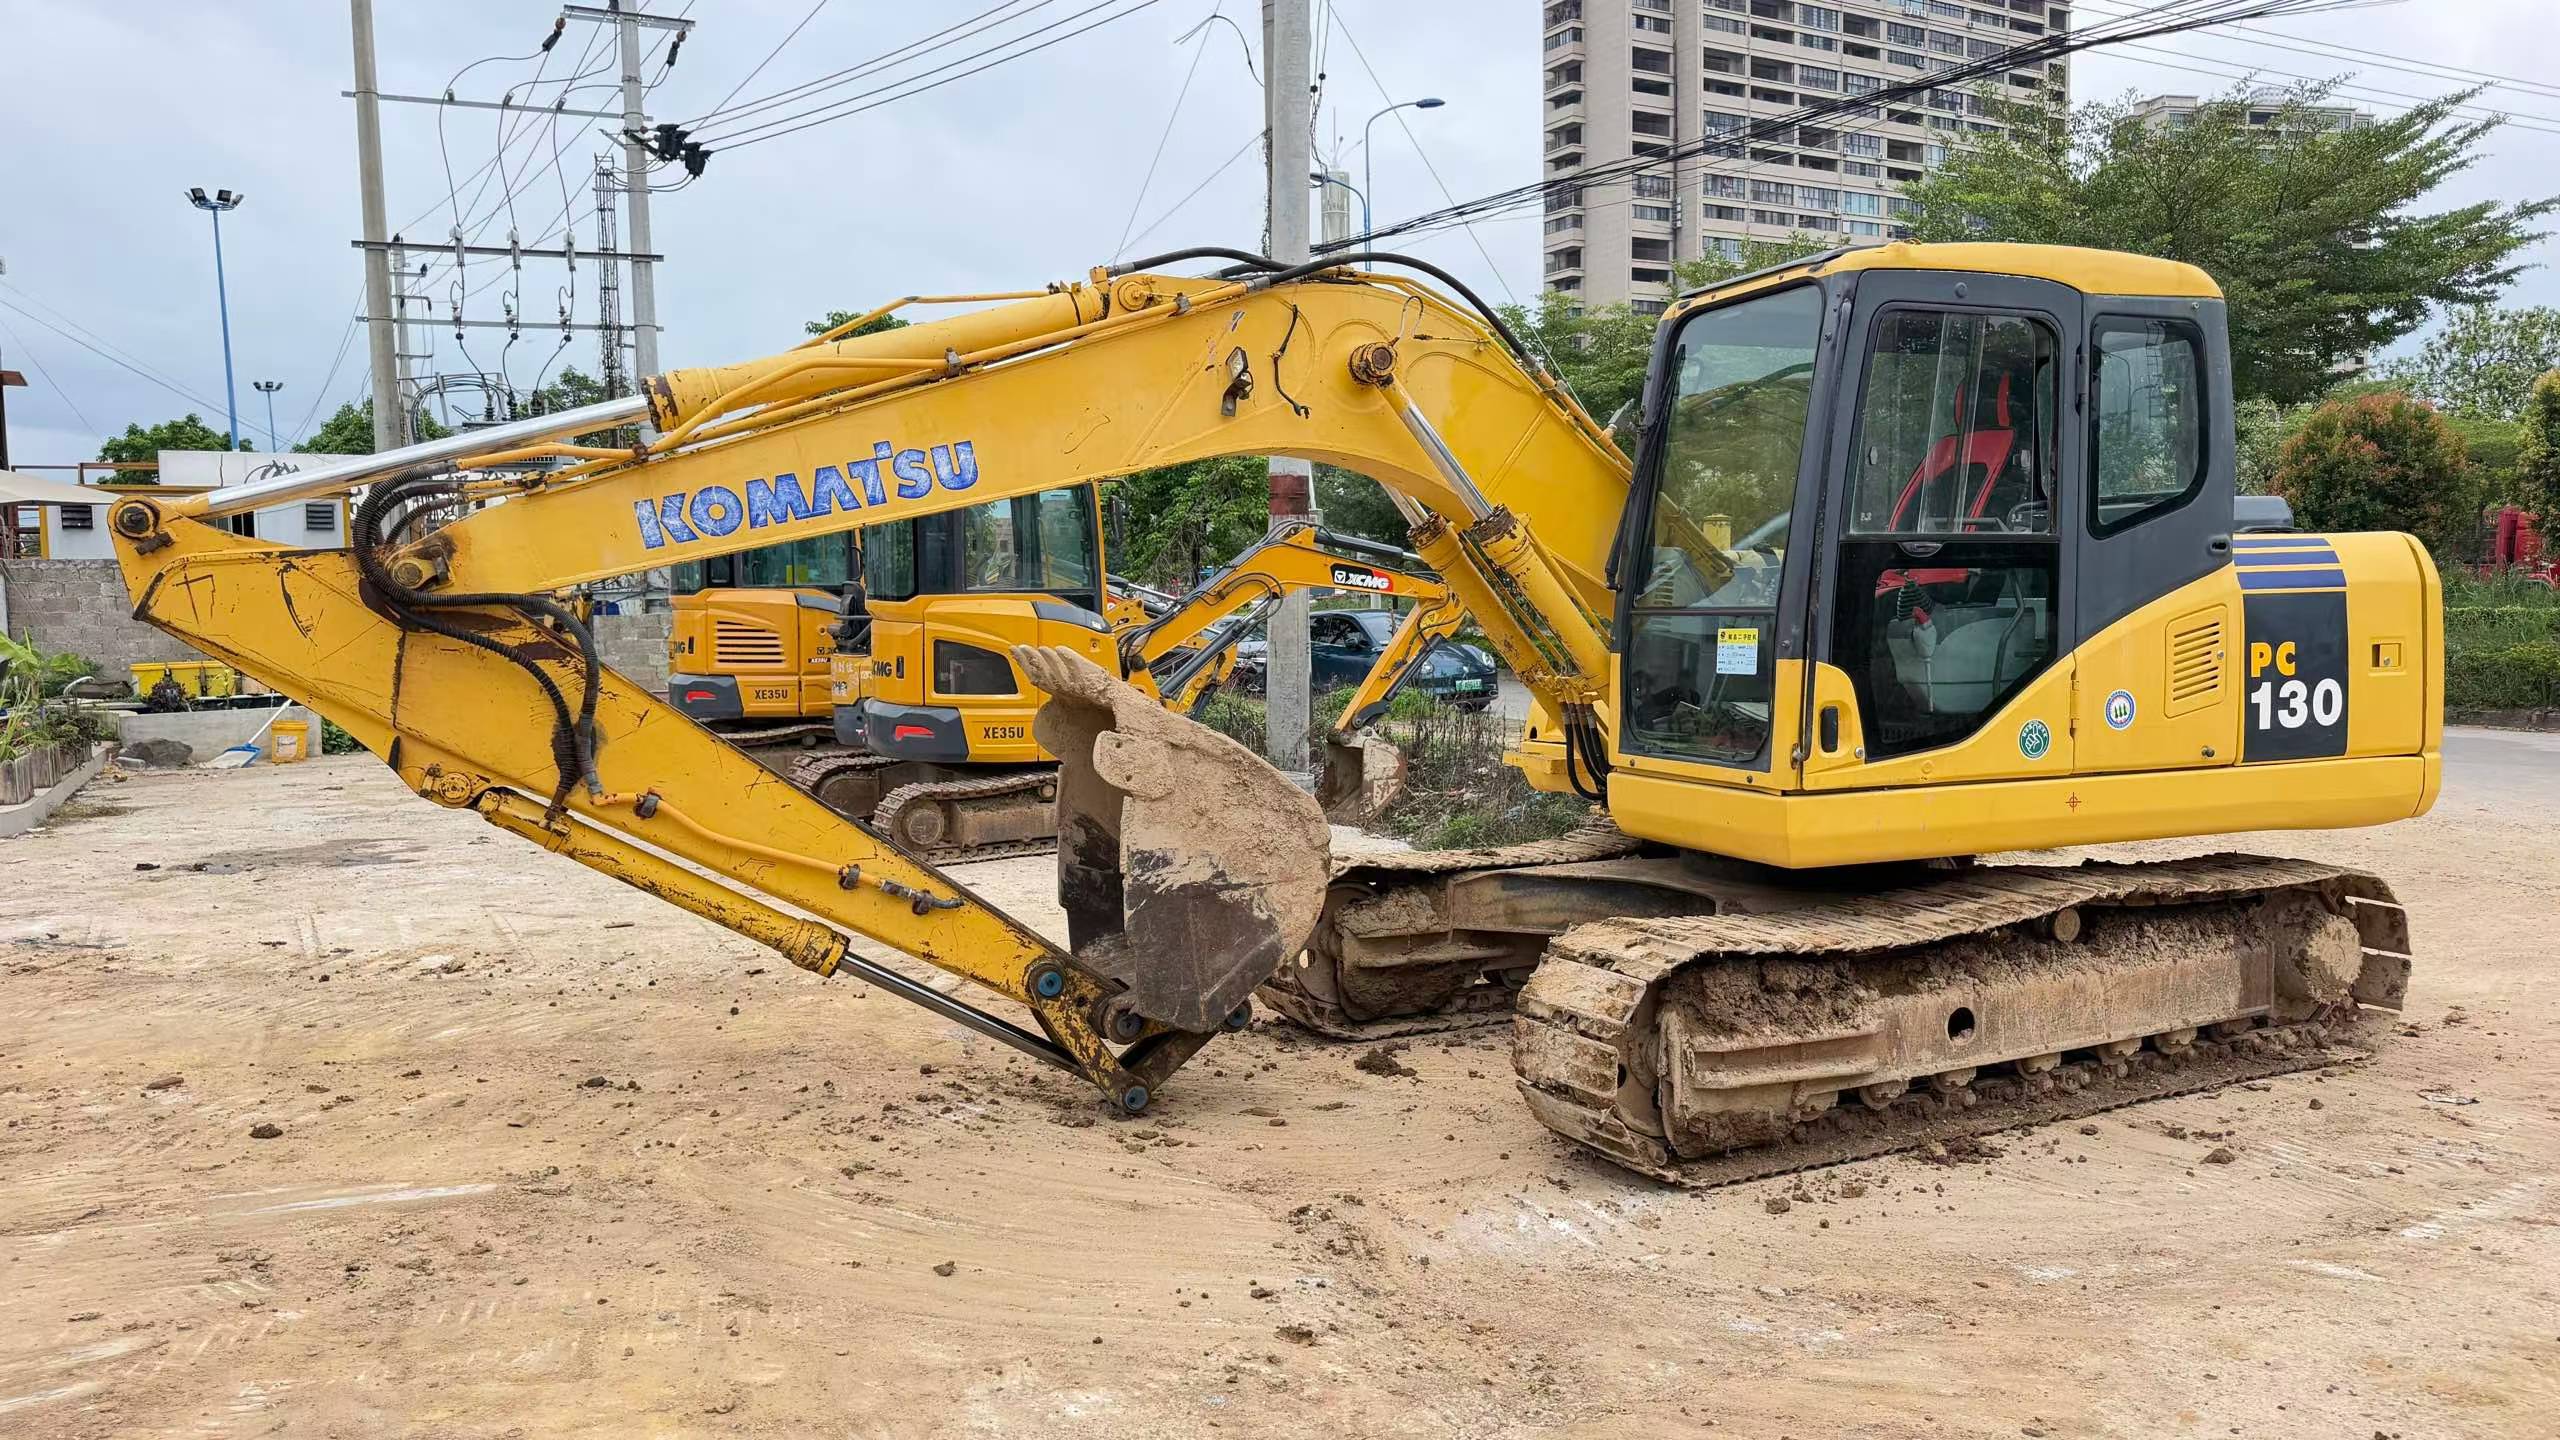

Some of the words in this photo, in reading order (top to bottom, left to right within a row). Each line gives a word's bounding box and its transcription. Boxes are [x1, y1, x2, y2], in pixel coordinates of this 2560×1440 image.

[633, 440, 979, 549] KOMATSU
[1345, 572, 1390, 589] XCMG
[2250, 641, 2296, 678] PC
[754, 689, 789, 700] XE35U
[2250, 678, 2343, 730] 130
[983, 726, 1025, 739] XE35U
